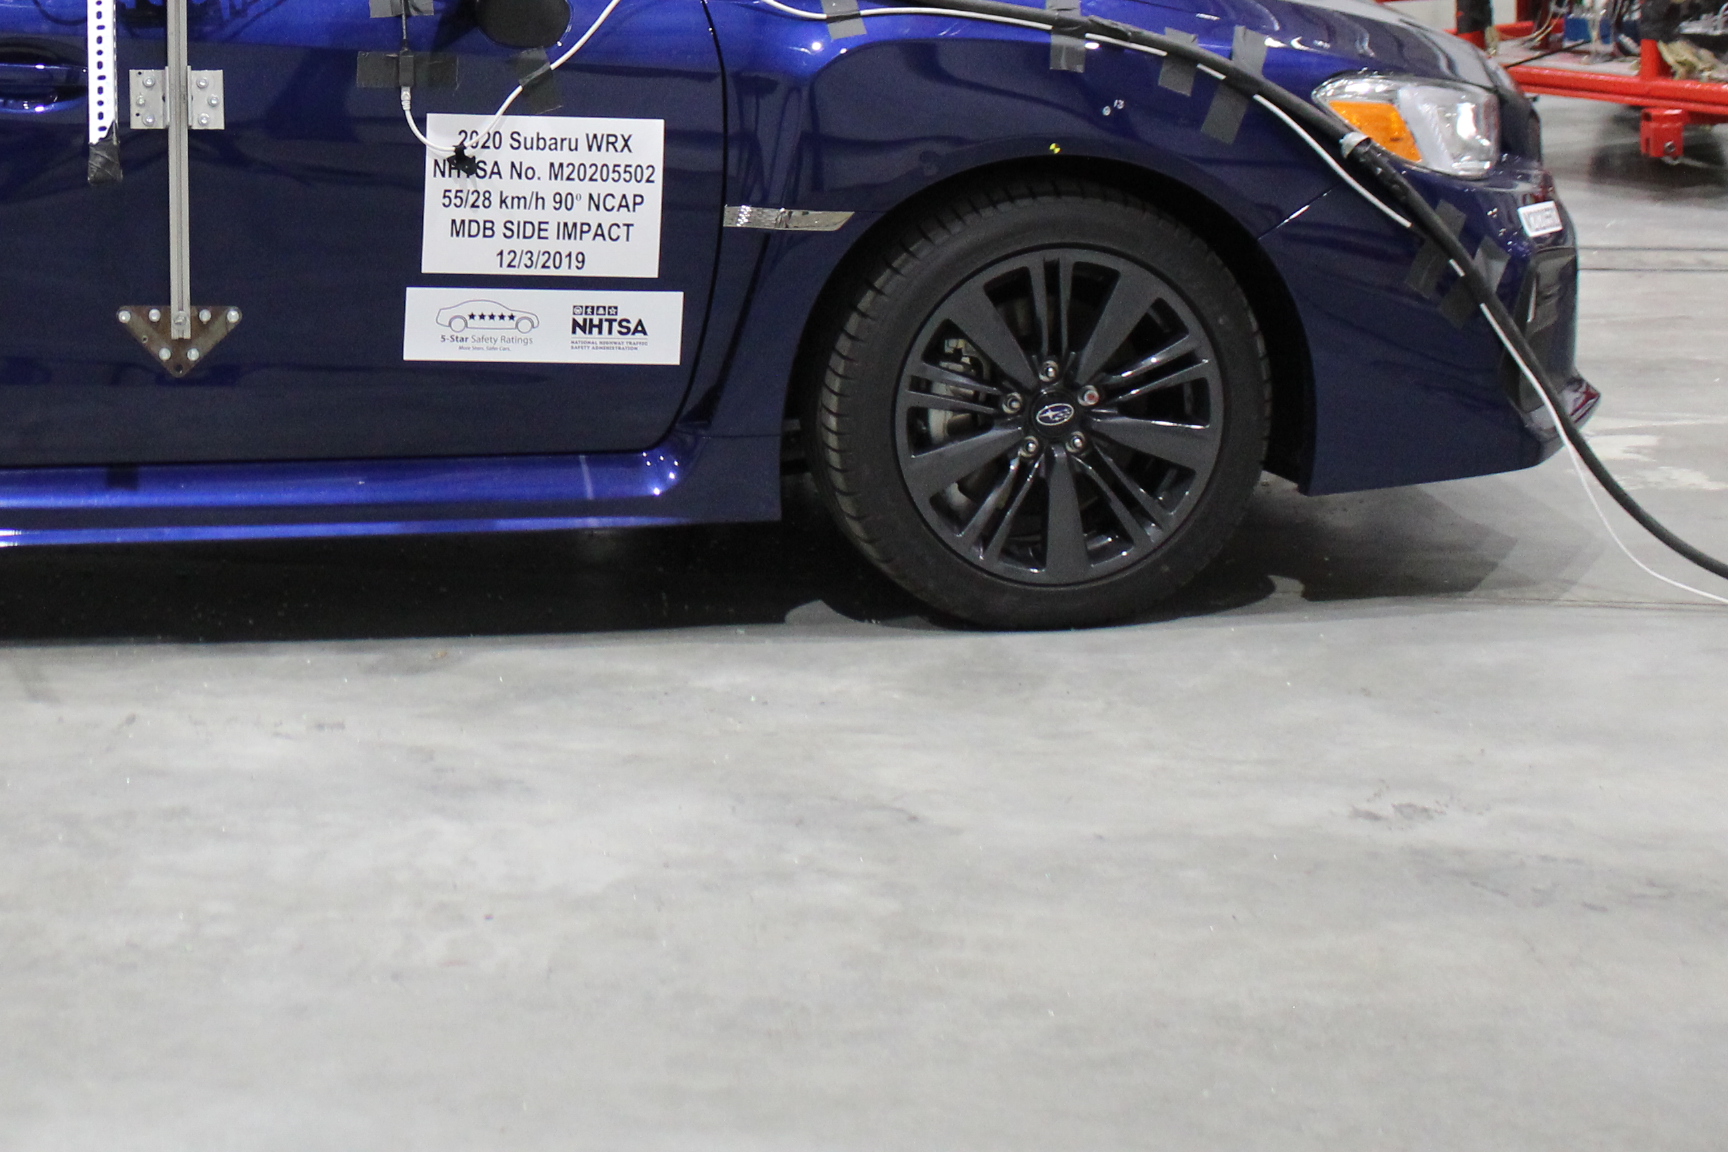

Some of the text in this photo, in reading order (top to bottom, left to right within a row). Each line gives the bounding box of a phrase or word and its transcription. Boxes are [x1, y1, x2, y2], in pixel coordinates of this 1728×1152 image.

[509, 131, 579, 152] Subaru
[586, 133, 633, 154] WRX
[433, 159, 655, 183] NHSA No. M20205502
[441, 190, 492, 209] 55/28
[499, 191, 545, 210] km/h
[587, 193, 645, 213] NCAP
[449, 219, 634, 242] MDB SIDE IMPACT
[496, 249, 586, 270] 12/3/2019
[571, 317, 648, 336] NHTSA
[440, 335, 533, 346] 5-Star Safety Ratings
